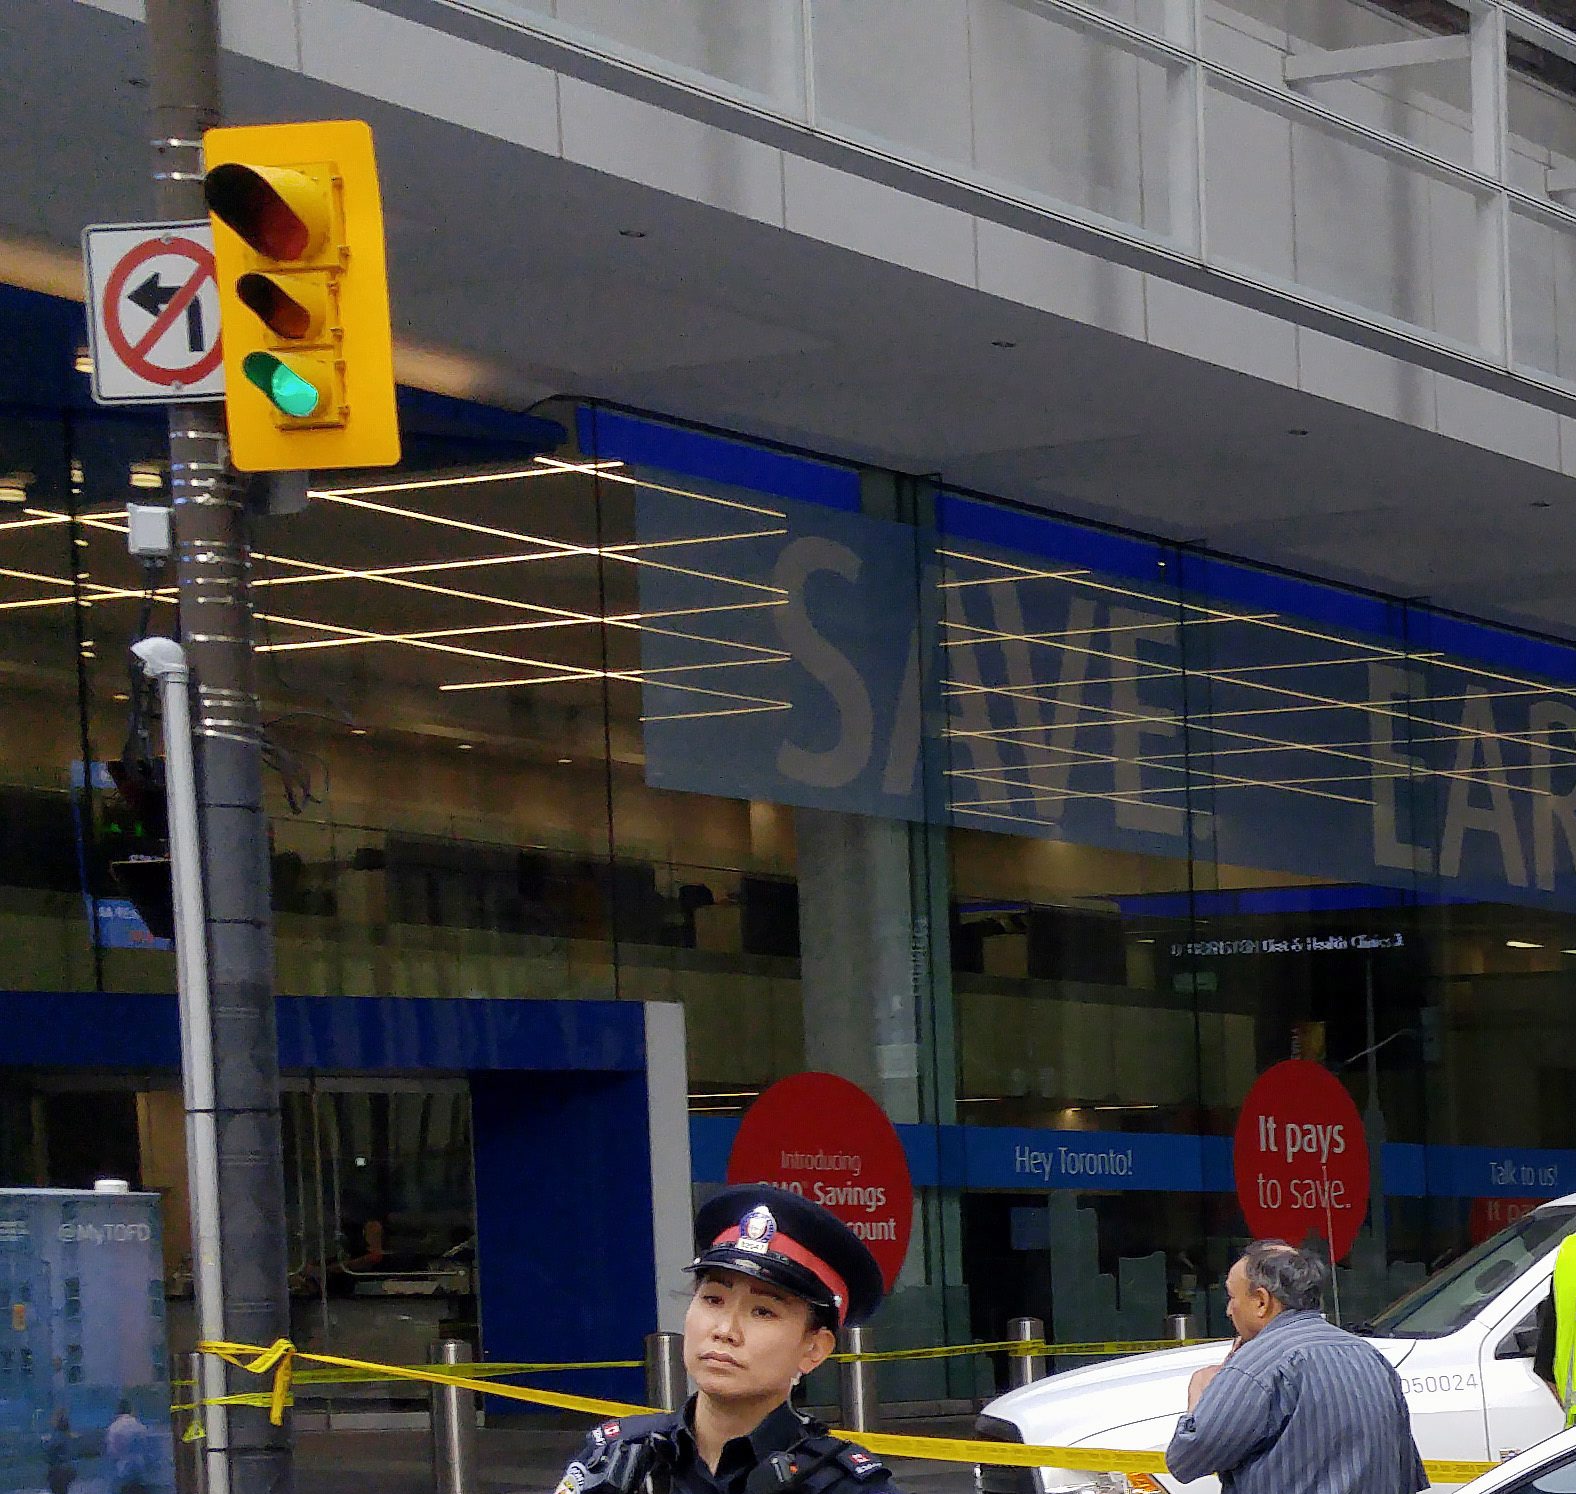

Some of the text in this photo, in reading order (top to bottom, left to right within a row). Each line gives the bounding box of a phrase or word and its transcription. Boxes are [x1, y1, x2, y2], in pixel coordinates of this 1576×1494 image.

[1259, 1115, 1346, 1163] It pays
[781, 1149, 862, 1176] Introducing
[1014, 1146, 1133, 1181] Hey Toronto!
[1489, 1161, 1559, 1187] Talk to us!
[813, 1181, 887, 1212] Savings
[1257, 1173, 1352, 1209] to save.
